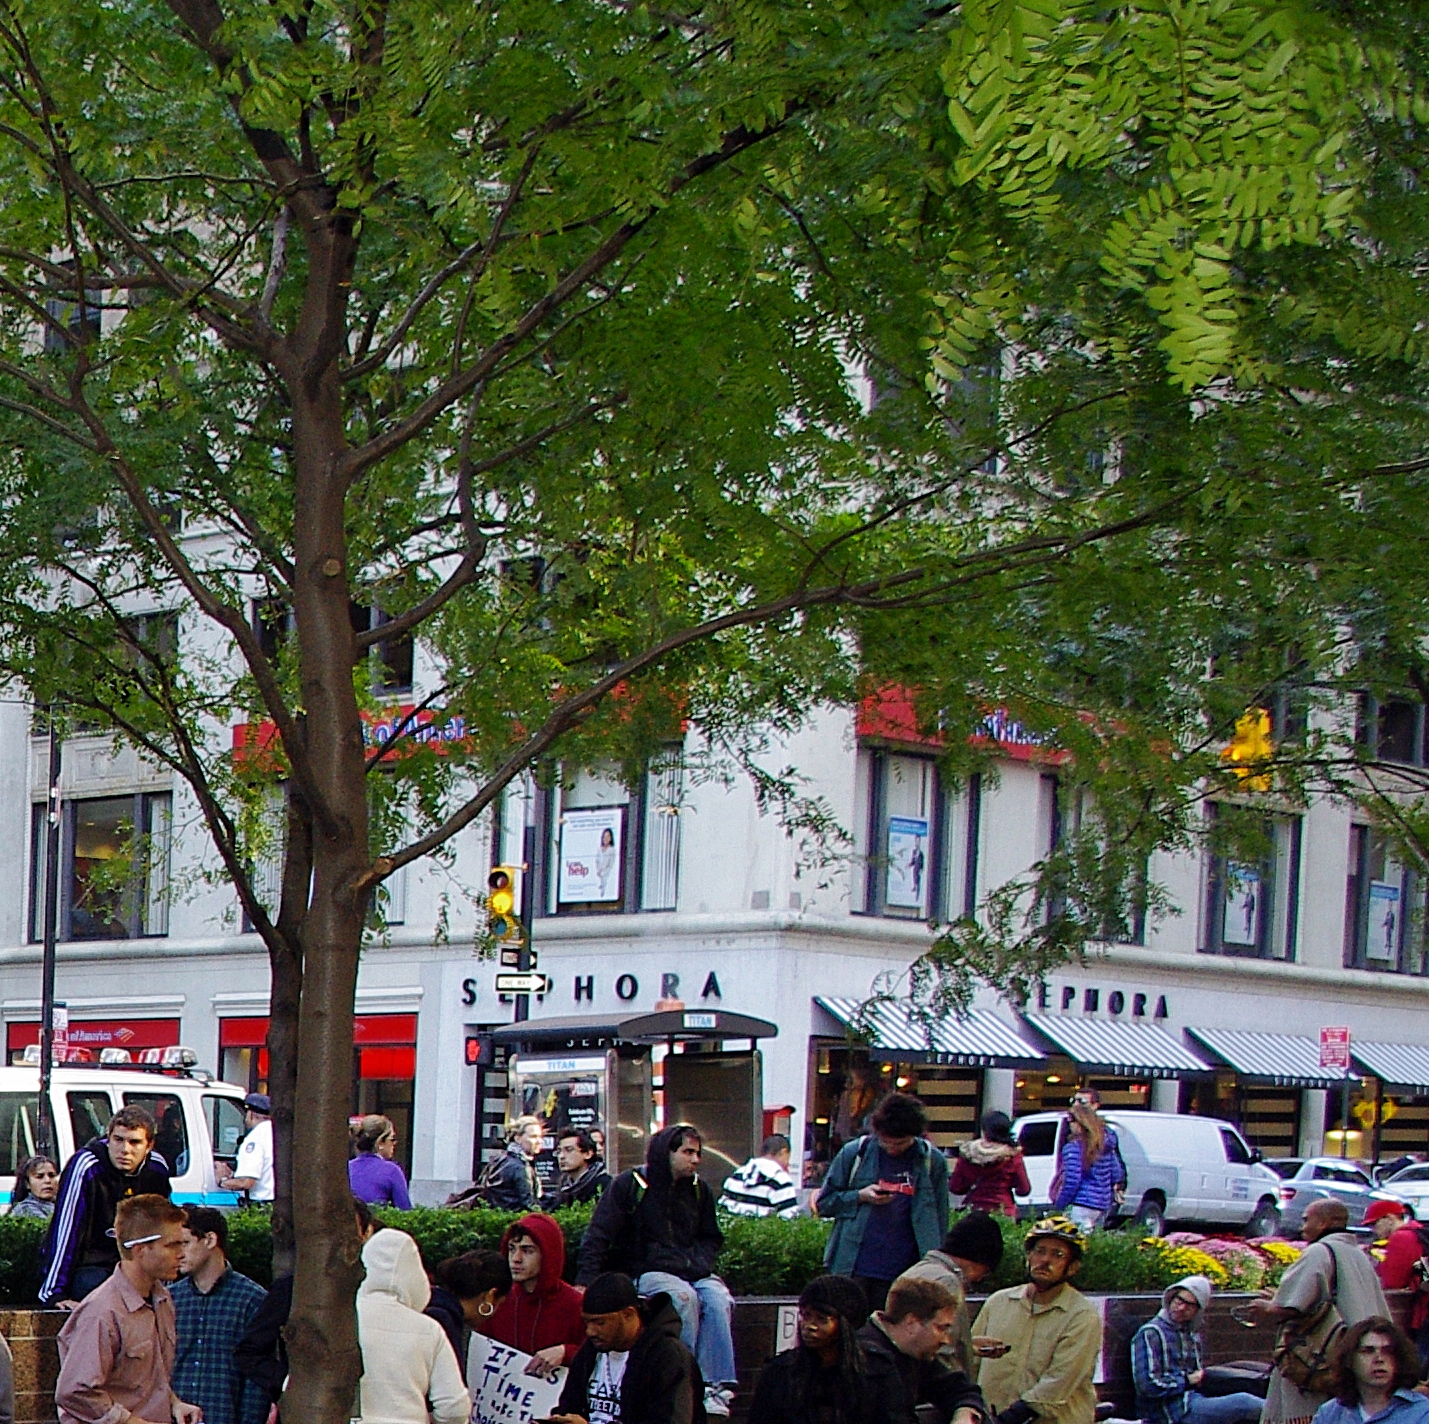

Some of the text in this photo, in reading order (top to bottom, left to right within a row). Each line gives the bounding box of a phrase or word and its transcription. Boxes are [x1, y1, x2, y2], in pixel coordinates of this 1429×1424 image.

[462, 970, 723, 1006] SHORA
[1038, 983, 1170, 1019] EPHORA
[687, 1014, 715, 1027] TITAN
[546, 1060, 576, 1070] TITAN
